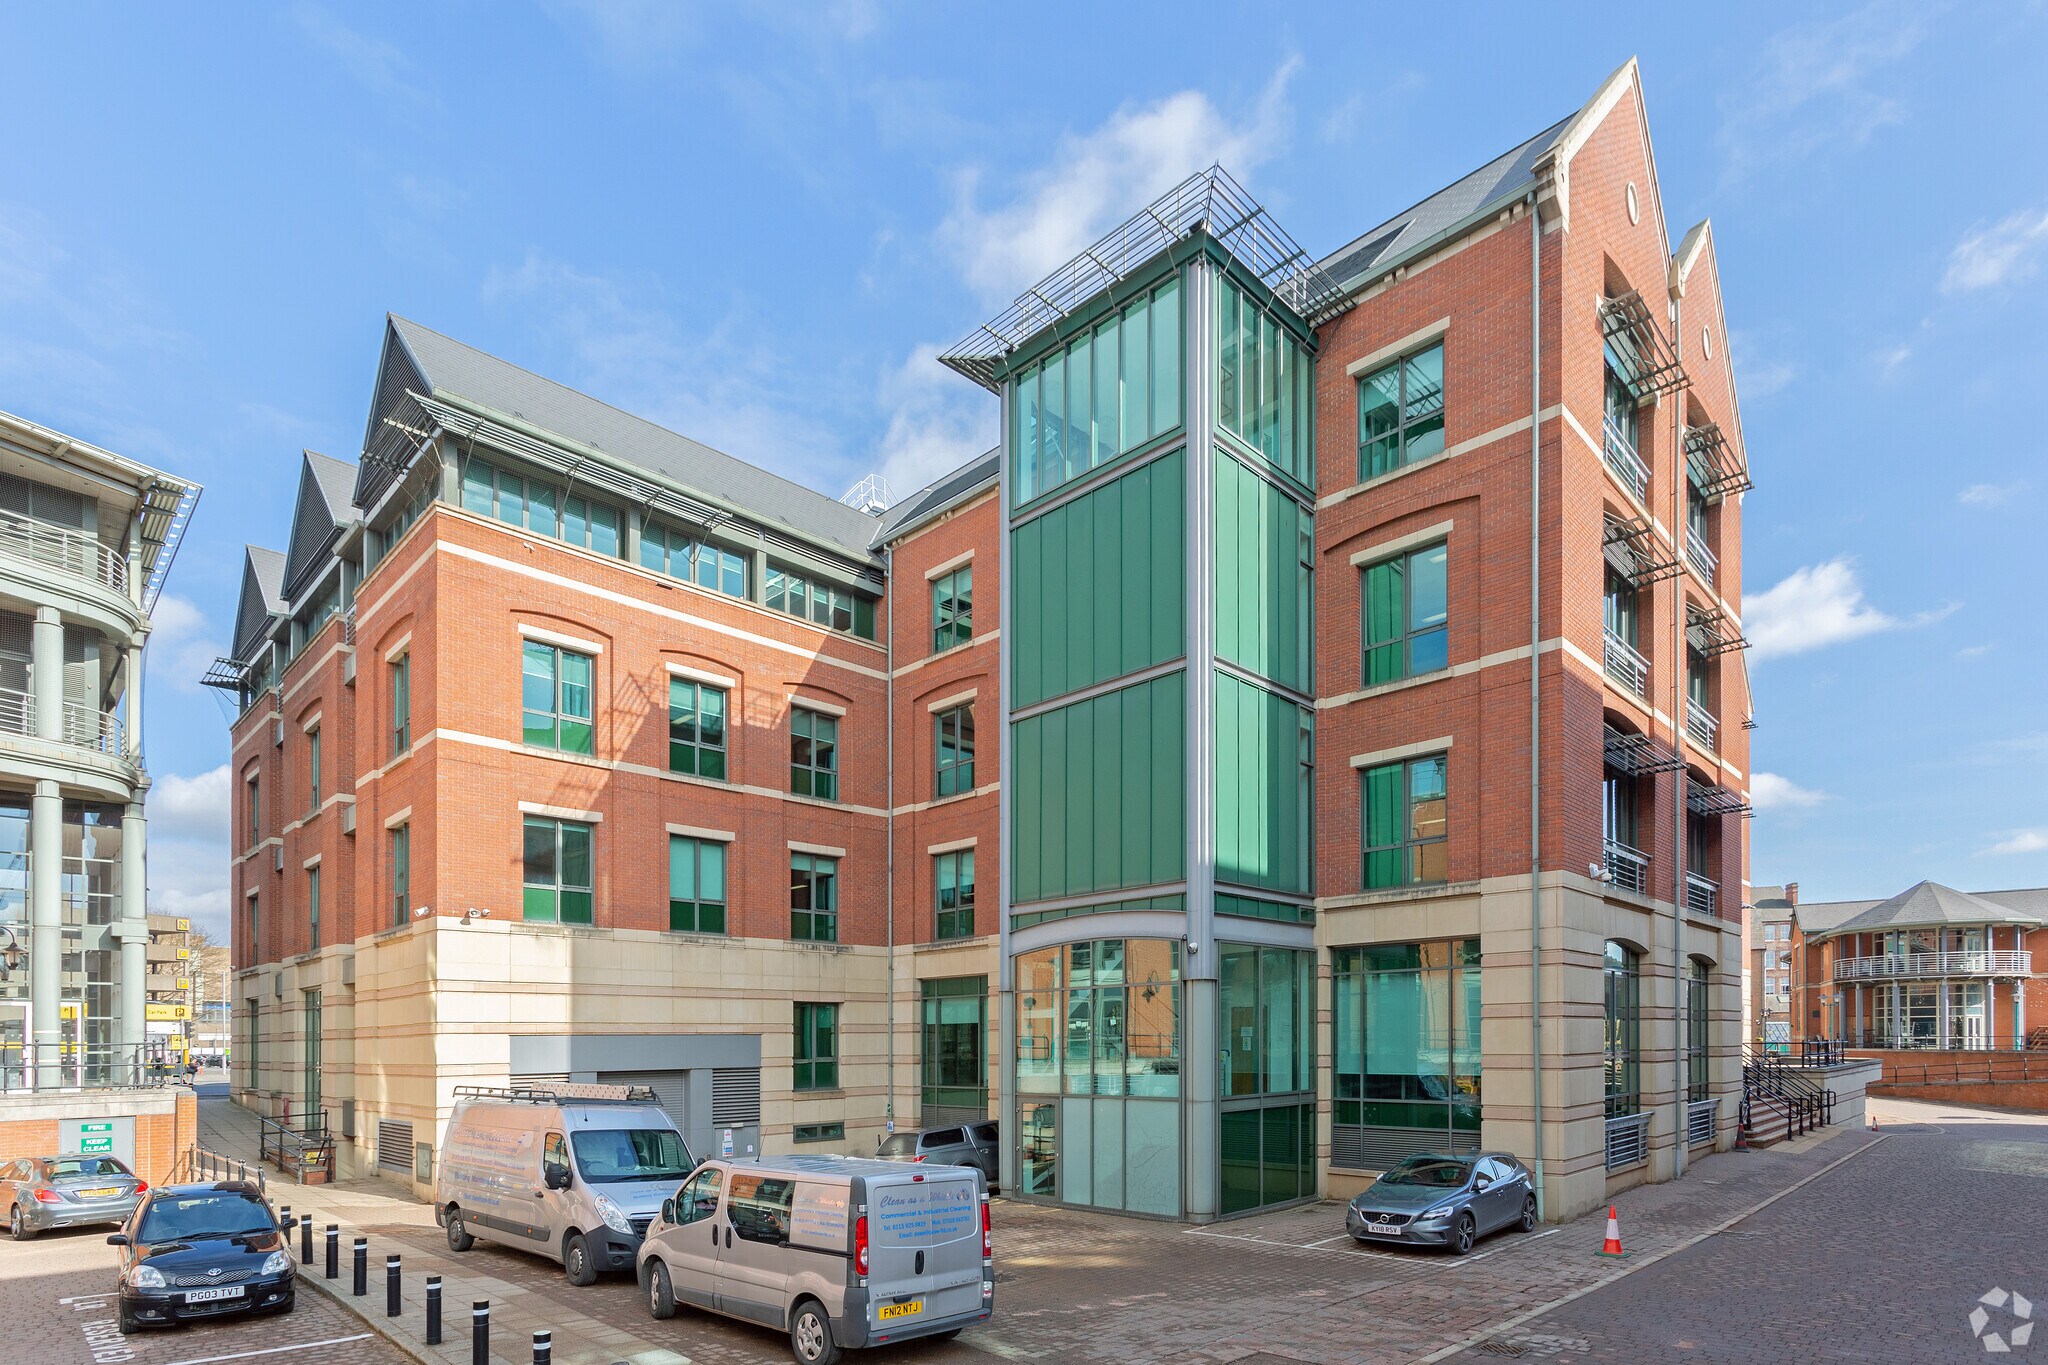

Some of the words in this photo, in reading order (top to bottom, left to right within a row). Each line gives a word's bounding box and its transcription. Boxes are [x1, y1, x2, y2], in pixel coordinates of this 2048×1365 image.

[179, 920, 188, 929] N
[178, 950, 187, 958] C
[179, 979, 187, 988] P
[880, 1195, 906, 1208] Clean
[881, 1209, 917, 1220] Commercial
[950, 1205, 971, 1213] Cleaning
[191, 1291, 218, 1301] PG03
[221, 1288, 240, 1297] TVT
[884, 1306, 902, 1317] FN12
[903, 1303, 918, 1314] NTJ
[80, 1318, 136, 1363] RESERVED
